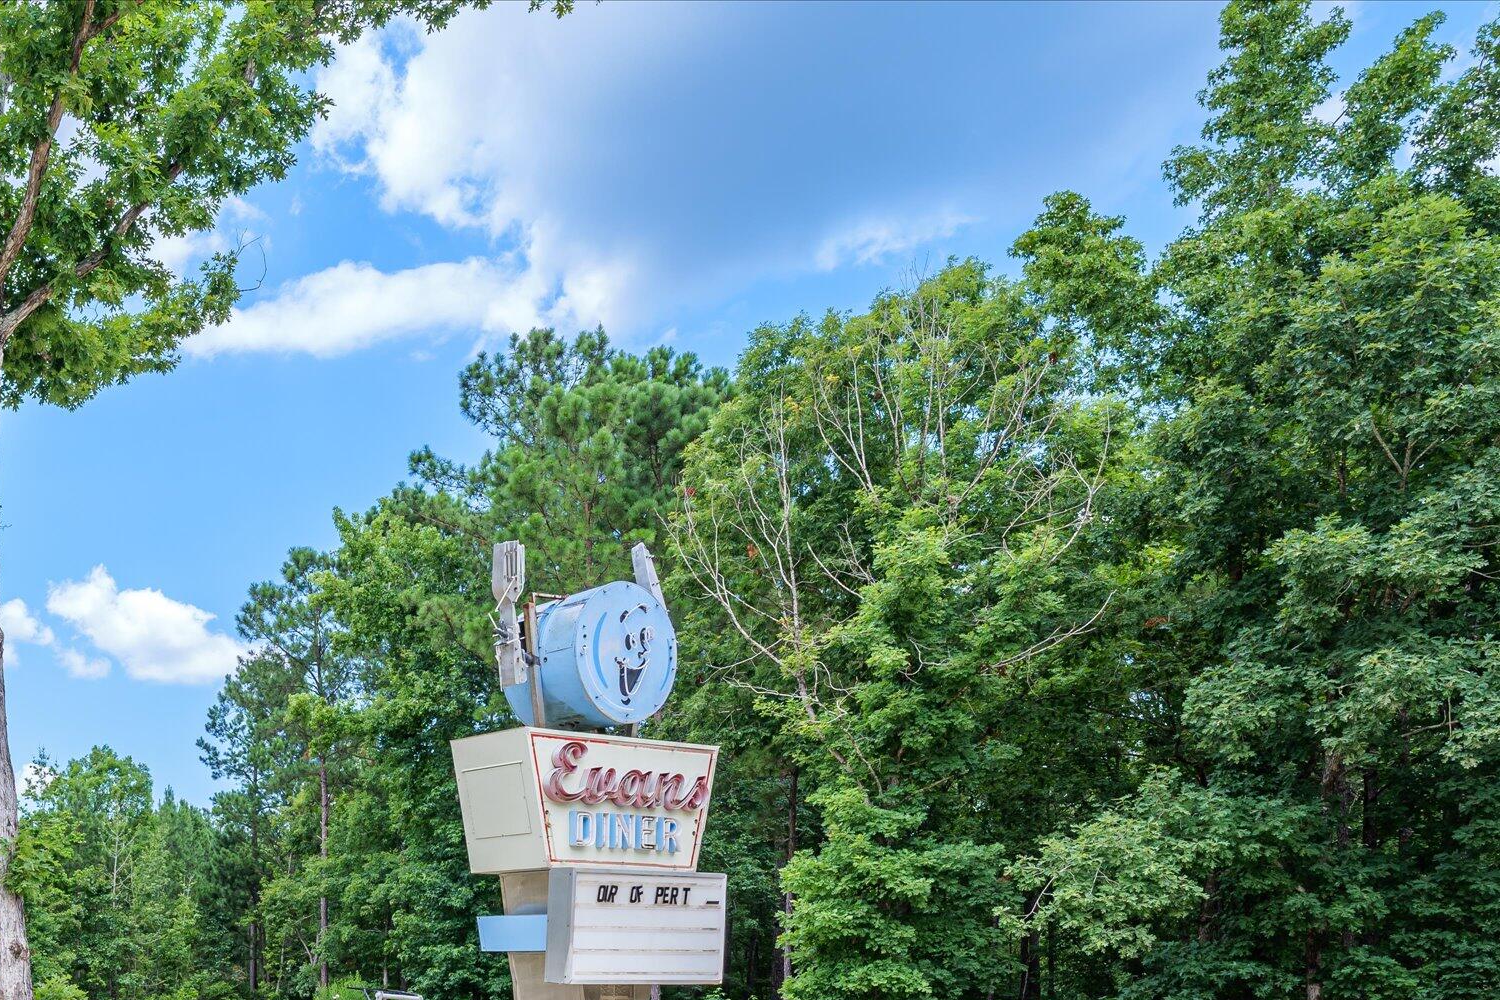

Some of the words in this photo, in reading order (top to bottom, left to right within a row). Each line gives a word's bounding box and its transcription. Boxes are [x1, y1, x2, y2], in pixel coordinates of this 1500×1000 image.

[543, 742, 709, 812] Evans
[569, 810, 683, 854] DINER
[629, 885, 644, 904] OF
